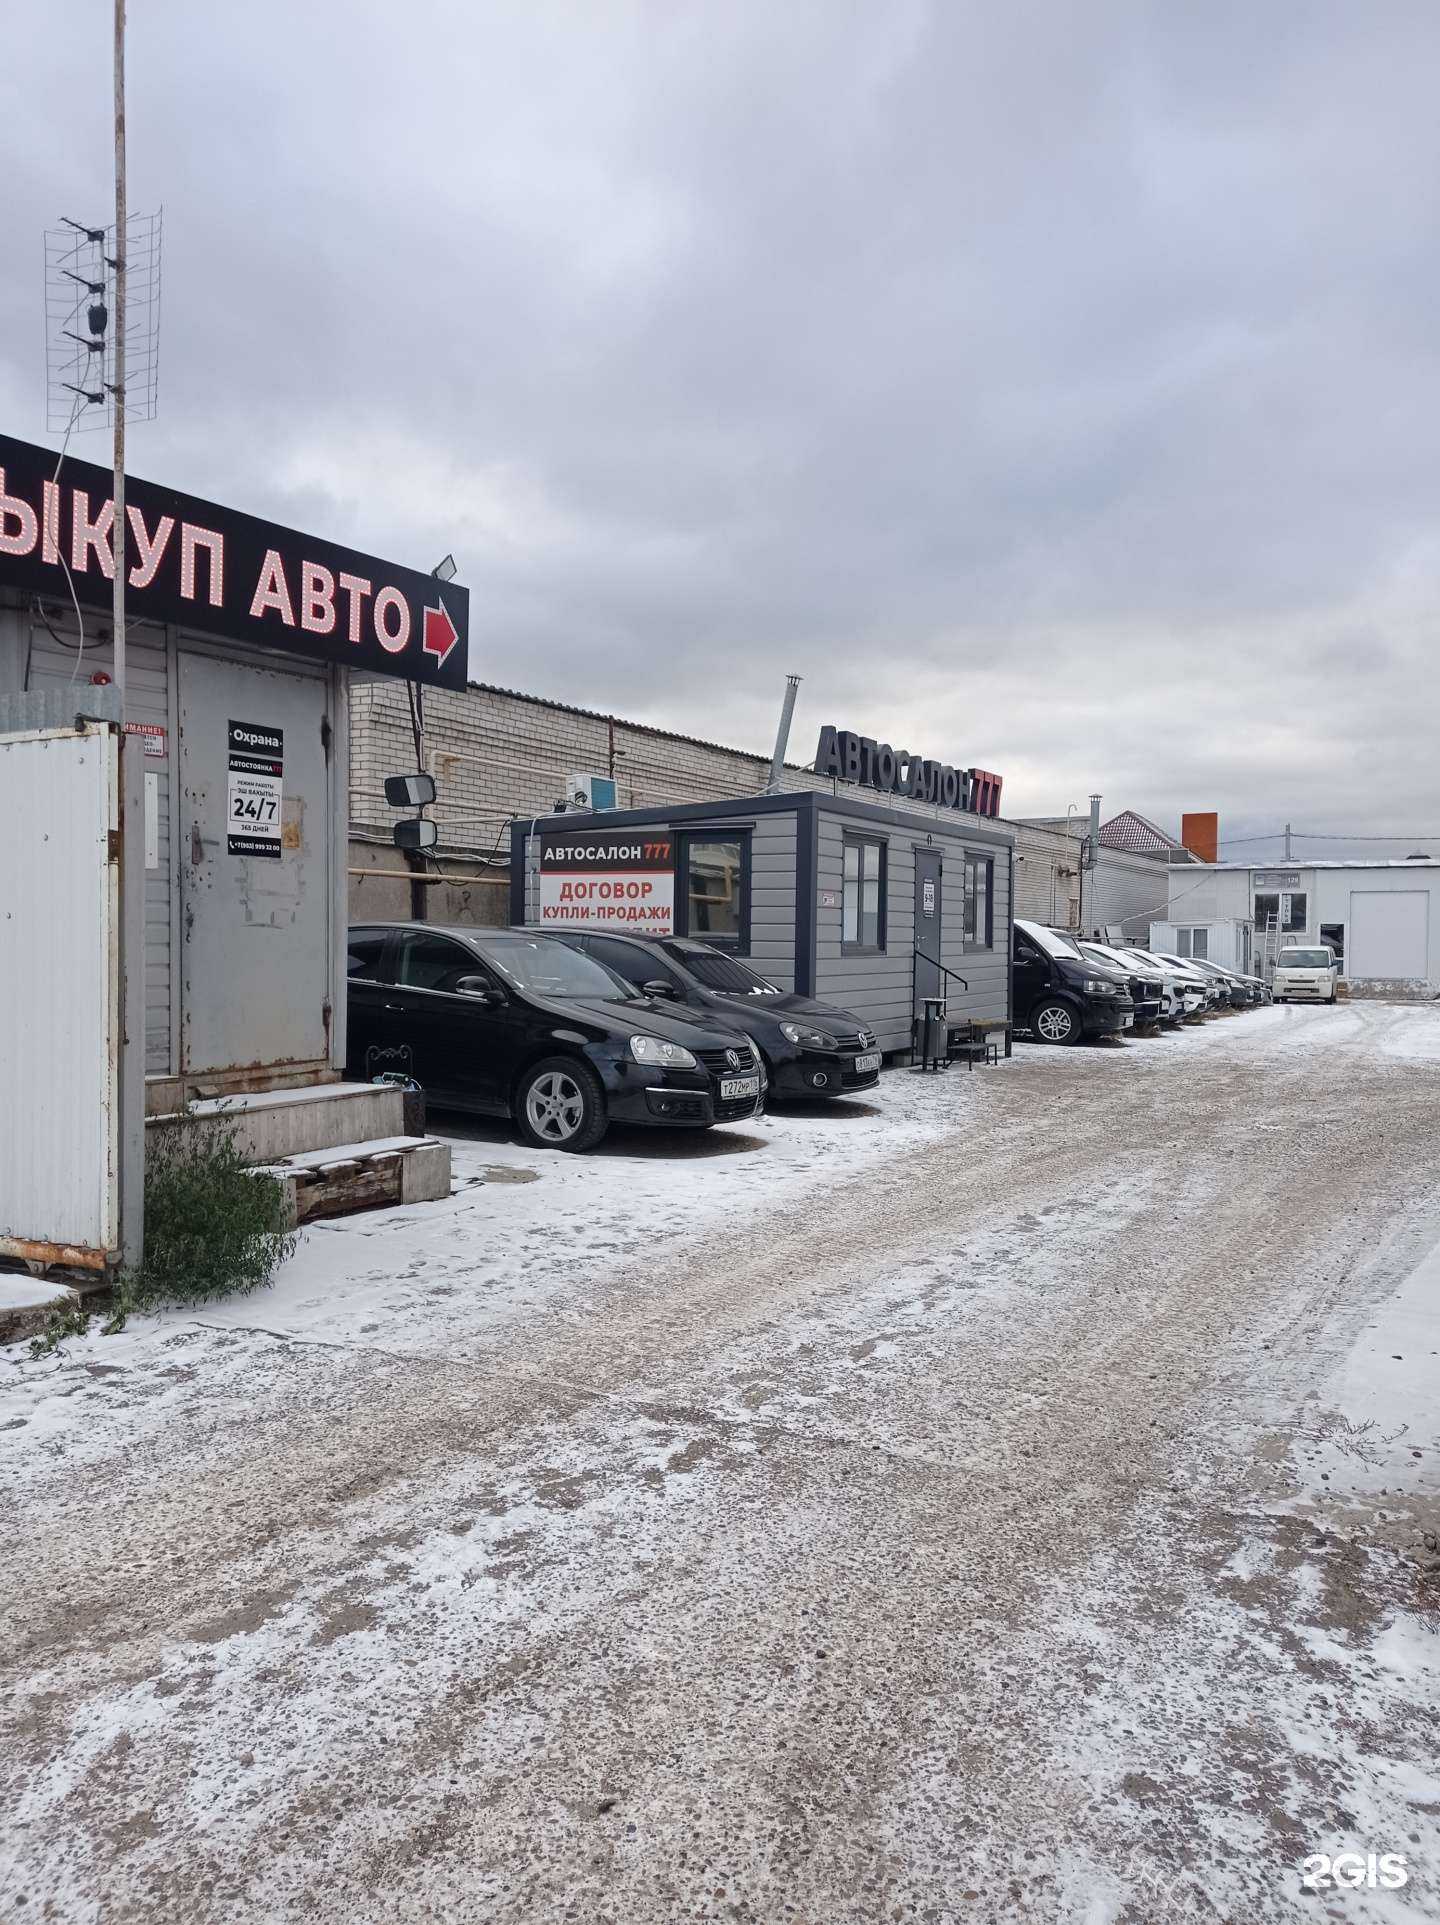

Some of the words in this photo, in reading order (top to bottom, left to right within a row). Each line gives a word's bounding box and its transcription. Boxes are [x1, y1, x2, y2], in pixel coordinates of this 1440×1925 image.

[249, 549, 411, 653] АВТО
[233, 728, 279, 747] Охрана
[814, 725, 972, 811] АВТОСАЛОН
[968, 768, 1003, 817] 777
[233, 797, 277, 821] 24/7
[544, 845, 641, 861] АВТОСАЛОН
[643, 843, 671, 860] 777
[559, 881, 653, 902] ДОГОВОР
[543, 905, 671, 922] КУПЛИ-ПРОДАЖИ
